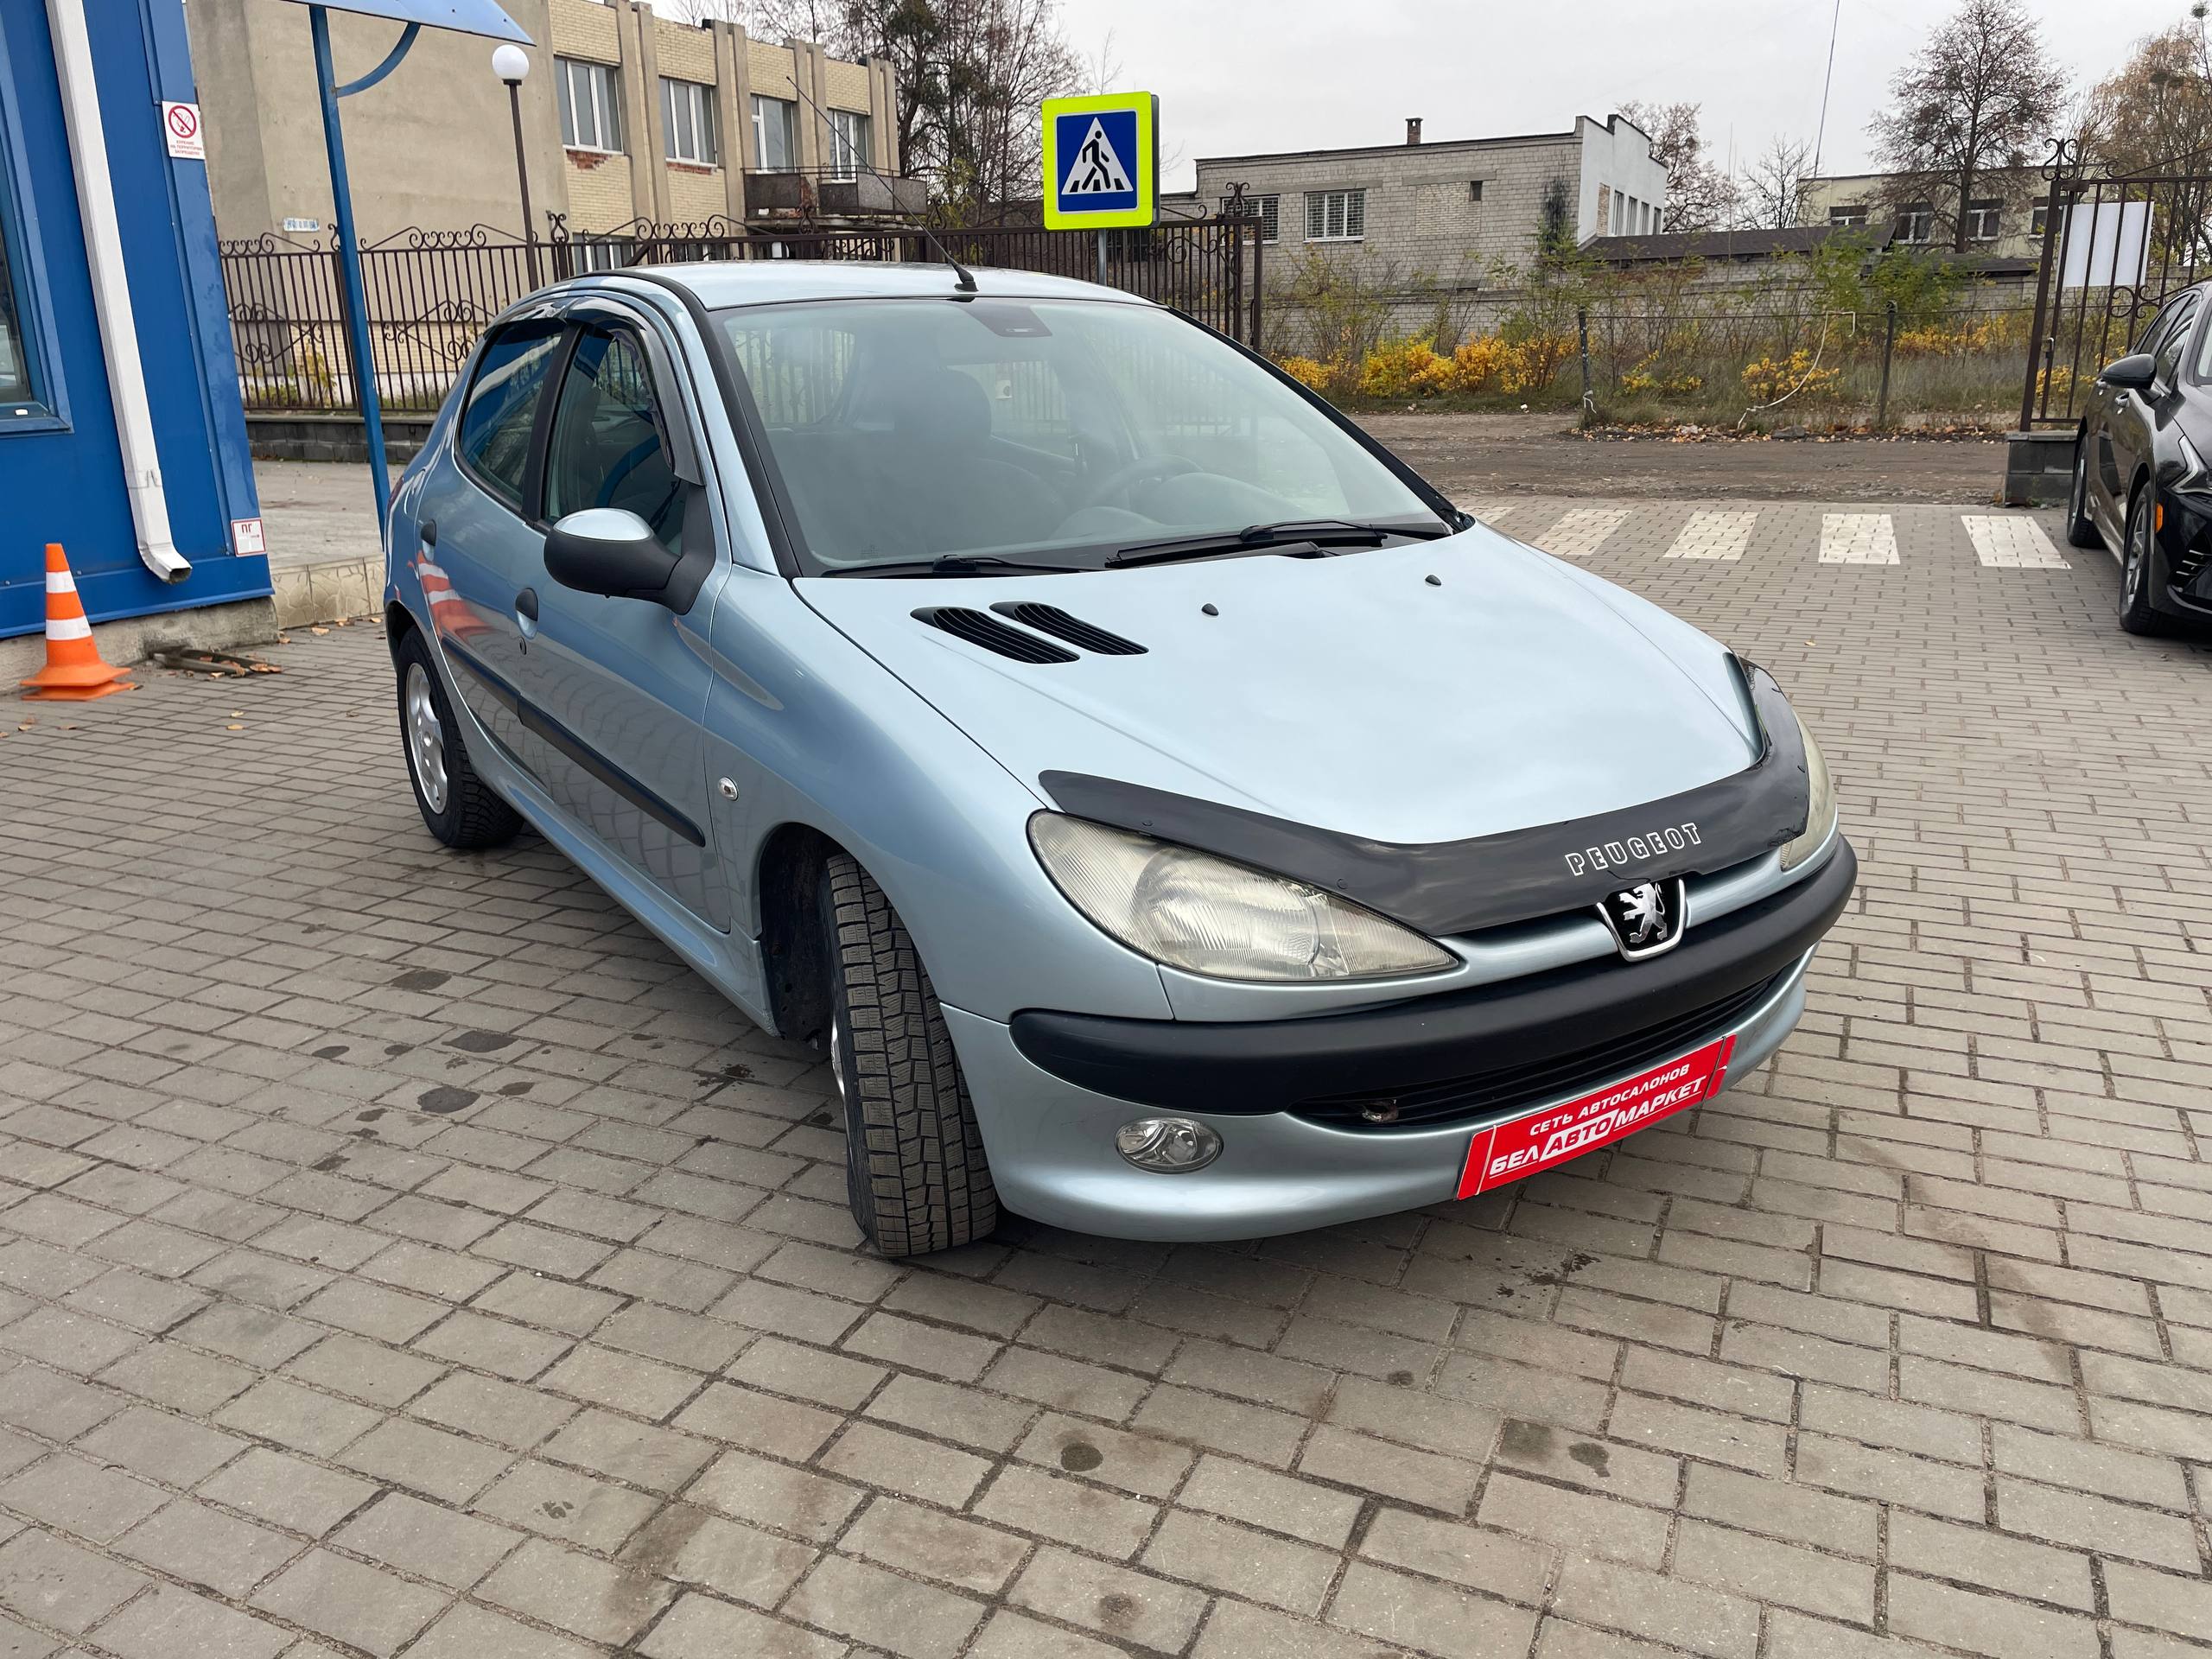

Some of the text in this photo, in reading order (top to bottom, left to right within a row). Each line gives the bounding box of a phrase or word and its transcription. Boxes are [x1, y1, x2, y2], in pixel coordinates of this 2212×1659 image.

[241, 524, 252, 533] ПГ
[1565, 823, 1701, 876] PEUGEOT
[1530, 1064, 1690, 1136] СЕТЬ АВТОСАЛОНОВ
